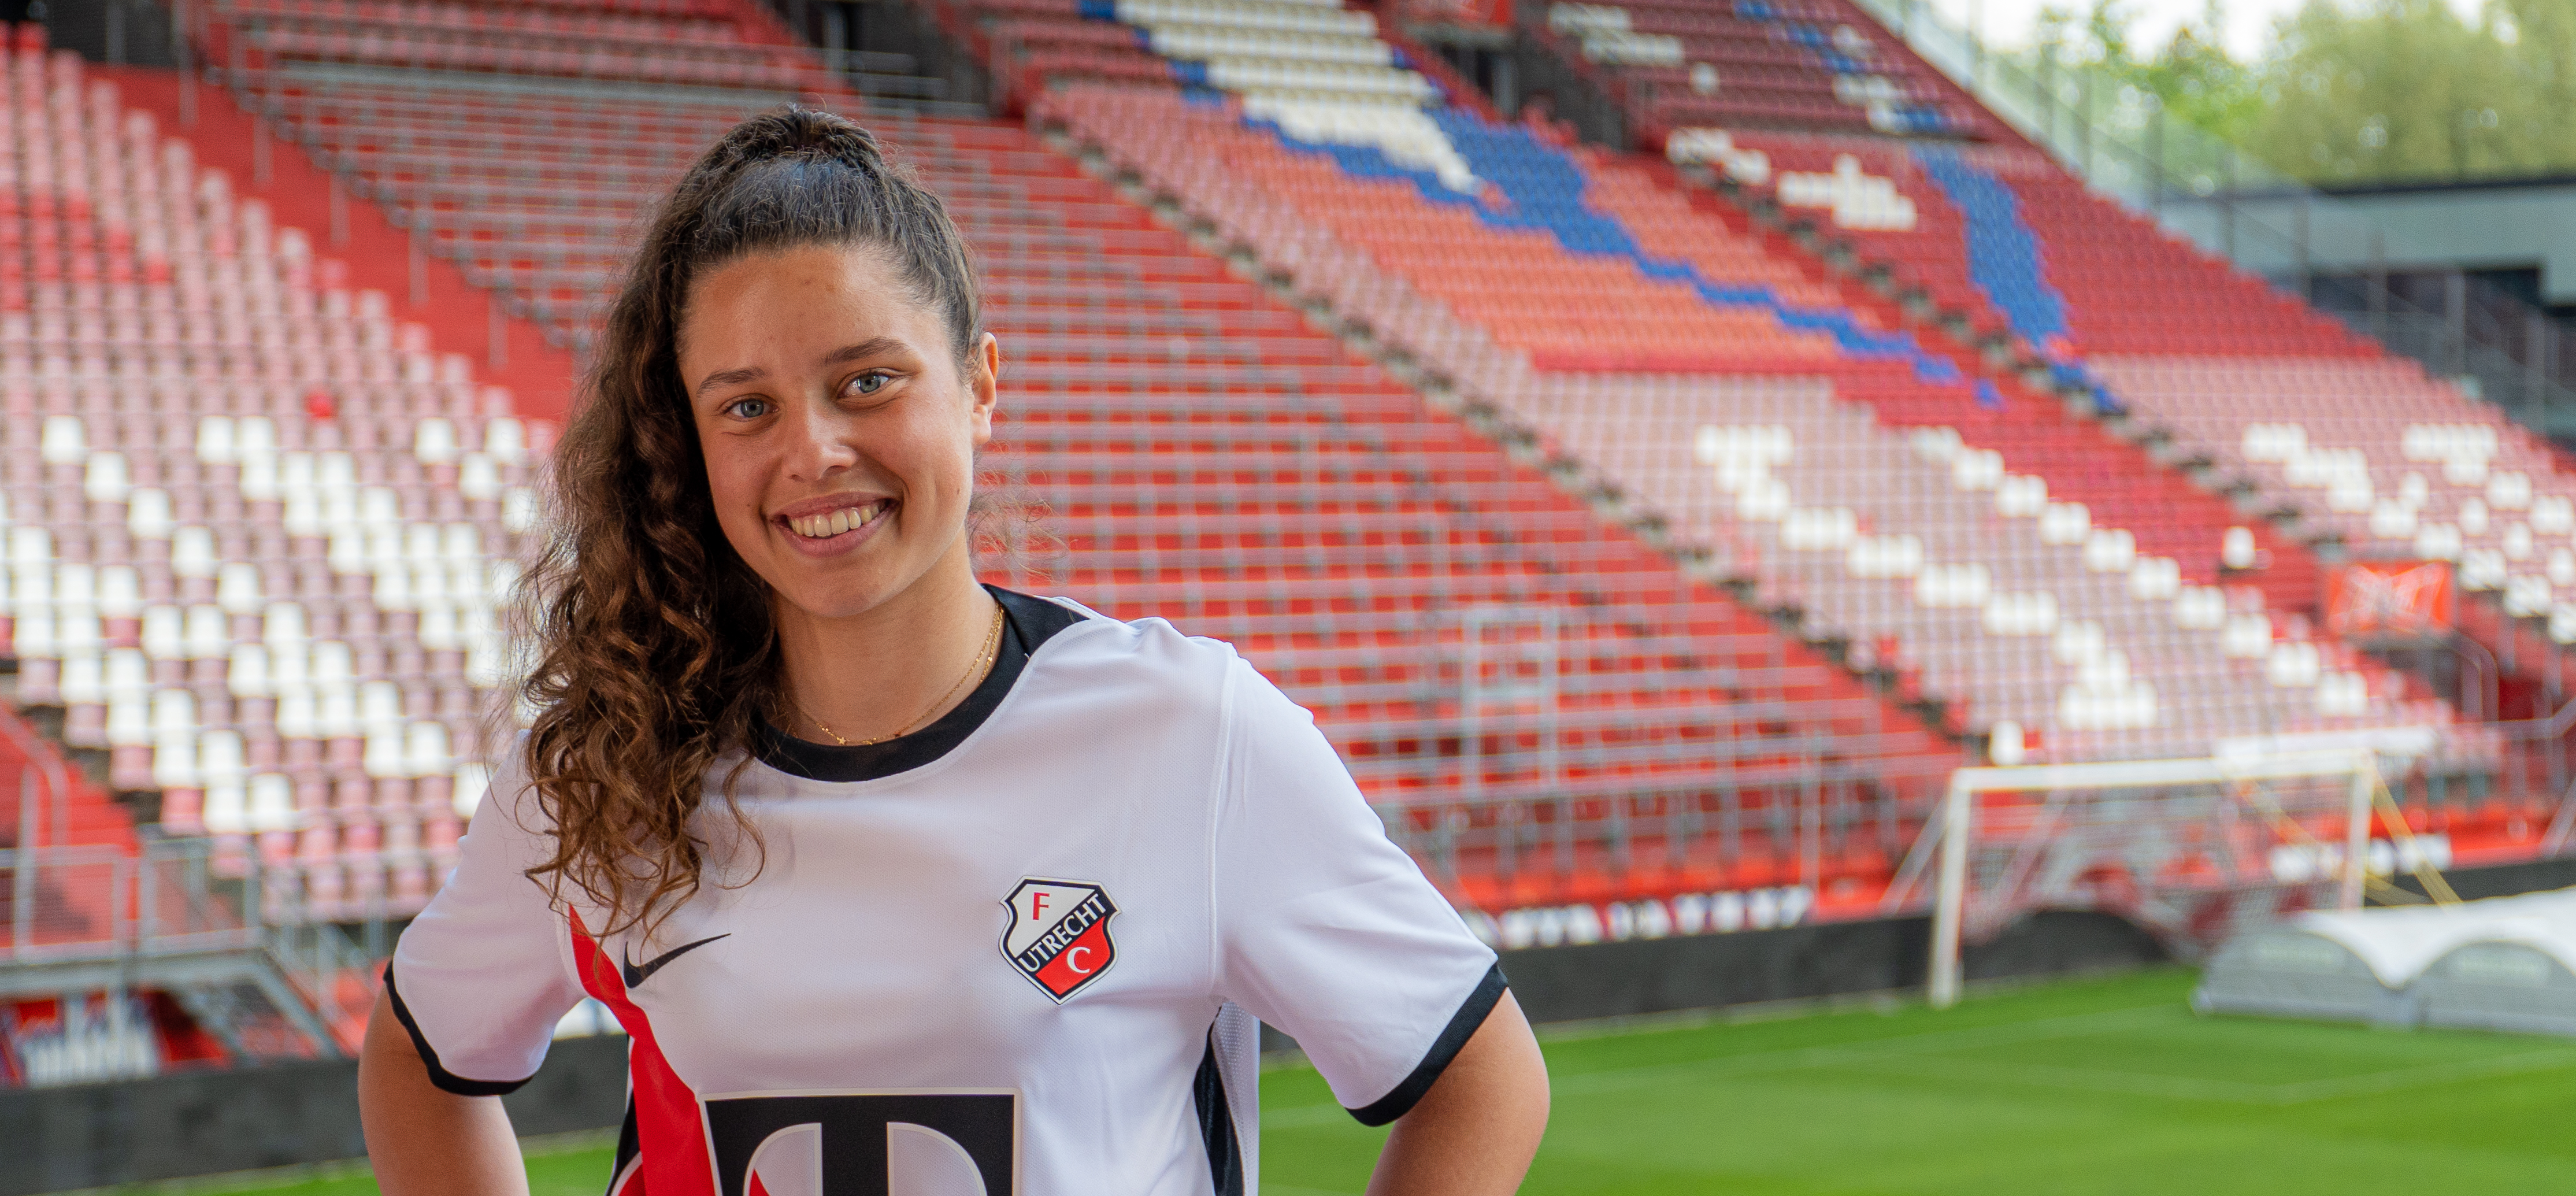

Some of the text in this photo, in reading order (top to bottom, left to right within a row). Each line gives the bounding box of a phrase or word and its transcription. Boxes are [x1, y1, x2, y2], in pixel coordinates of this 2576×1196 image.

[1032, 892, 1050, 921] F
[1017, 893, 1107, 972] UTRECHT
[1066, 946, 1091, 973] C
